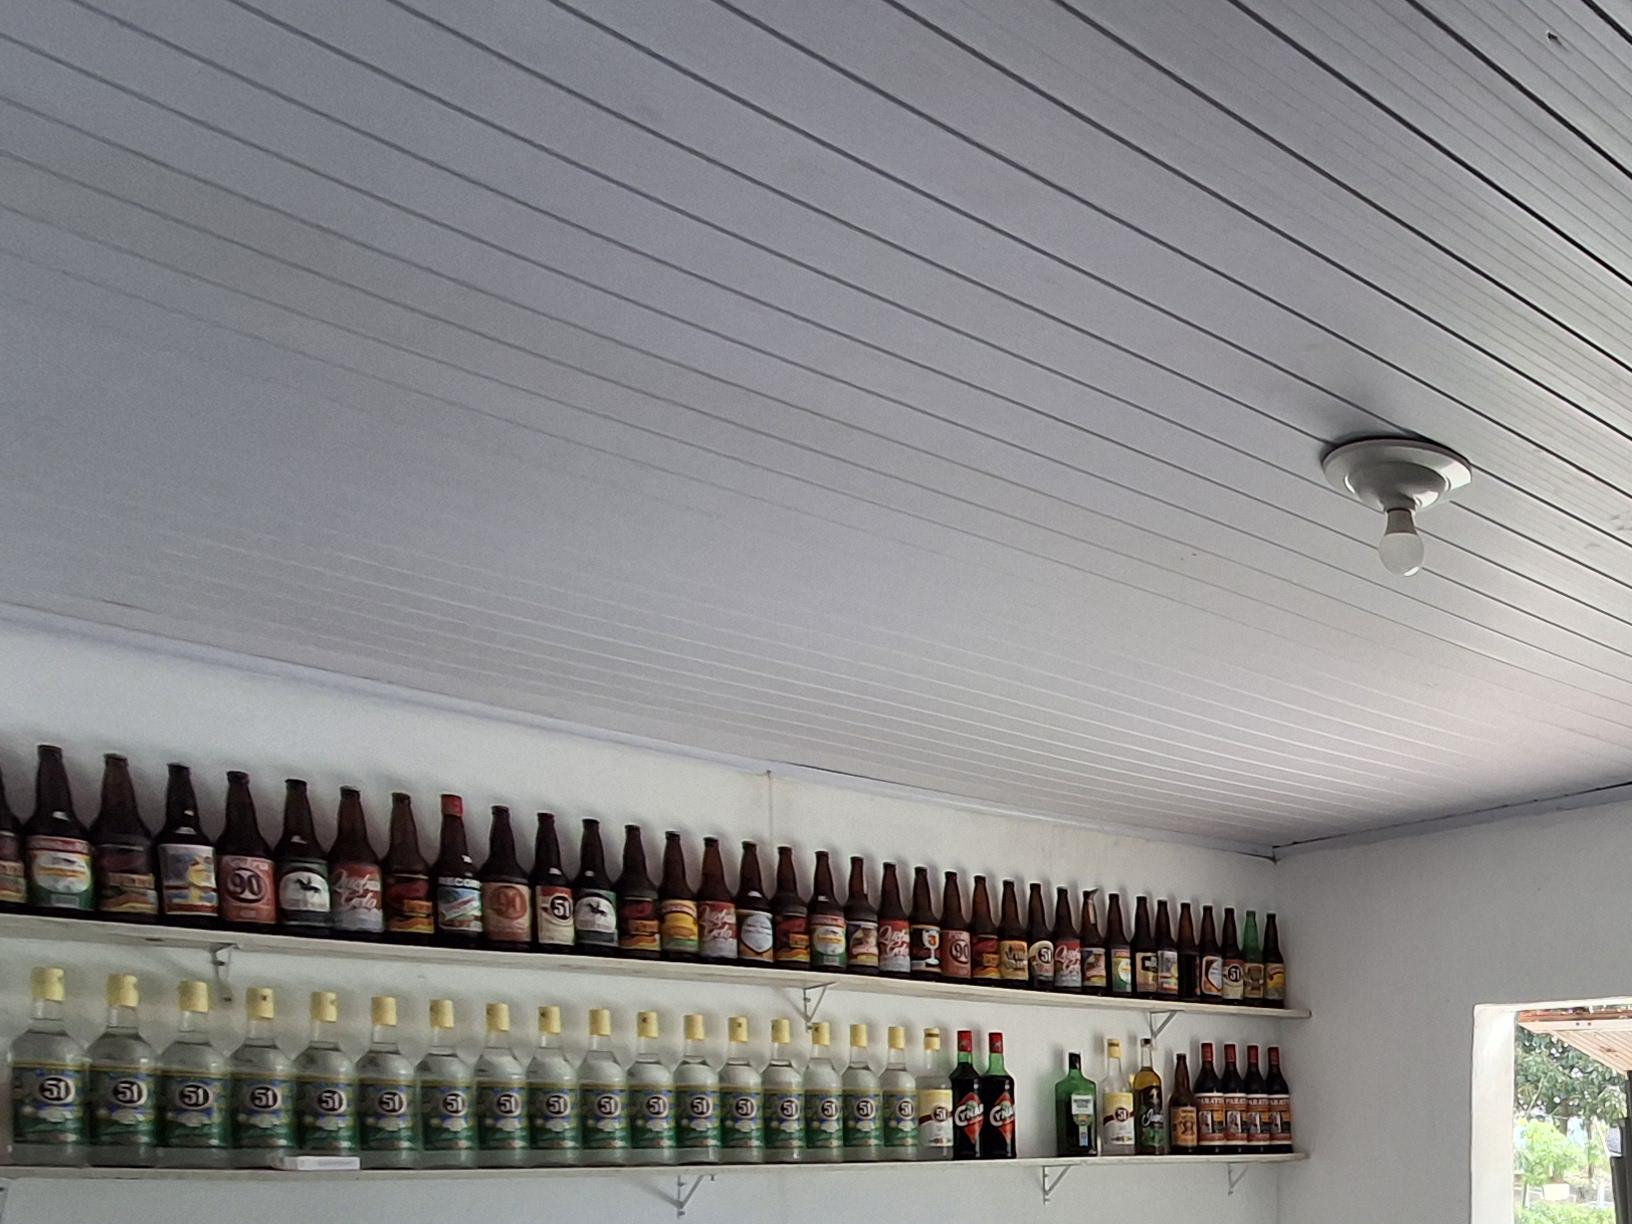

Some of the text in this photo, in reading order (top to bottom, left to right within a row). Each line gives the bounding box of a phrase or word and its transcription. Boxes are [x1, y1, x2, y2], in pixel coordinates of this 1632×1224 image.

[230, 872, 262, 896] 90
[553, 902, 571, 921] 51
[44, 1079, 68, 1099] 51
[117, 1086, 139, 1105] 51
[184, 1089, 205, 1108] 51
[254, 1090, 274, 1108] 51
[321, 1093, 340, 1110] 51
[382, 1096, 401, 1114] 51
[446, 1094, 463, 1111] 51
[500, 1095, 516, 1112] 51
[549, 1096, 565, 1112] 51
[600, 1098, 615, 1114] 51
[648, 1097, 665, 1112] 51
[693, 1097, 708, 1112] 51
[738, 1099, 752, 1115] 51
[783, 1101, 797, 1116] 51
[825, 1101, 837, 1116] 51
[860, 1101, 872, 1116] 51
[901, 1101, 913, 1116] 51
[936, 1108, 948, 1121] 51
